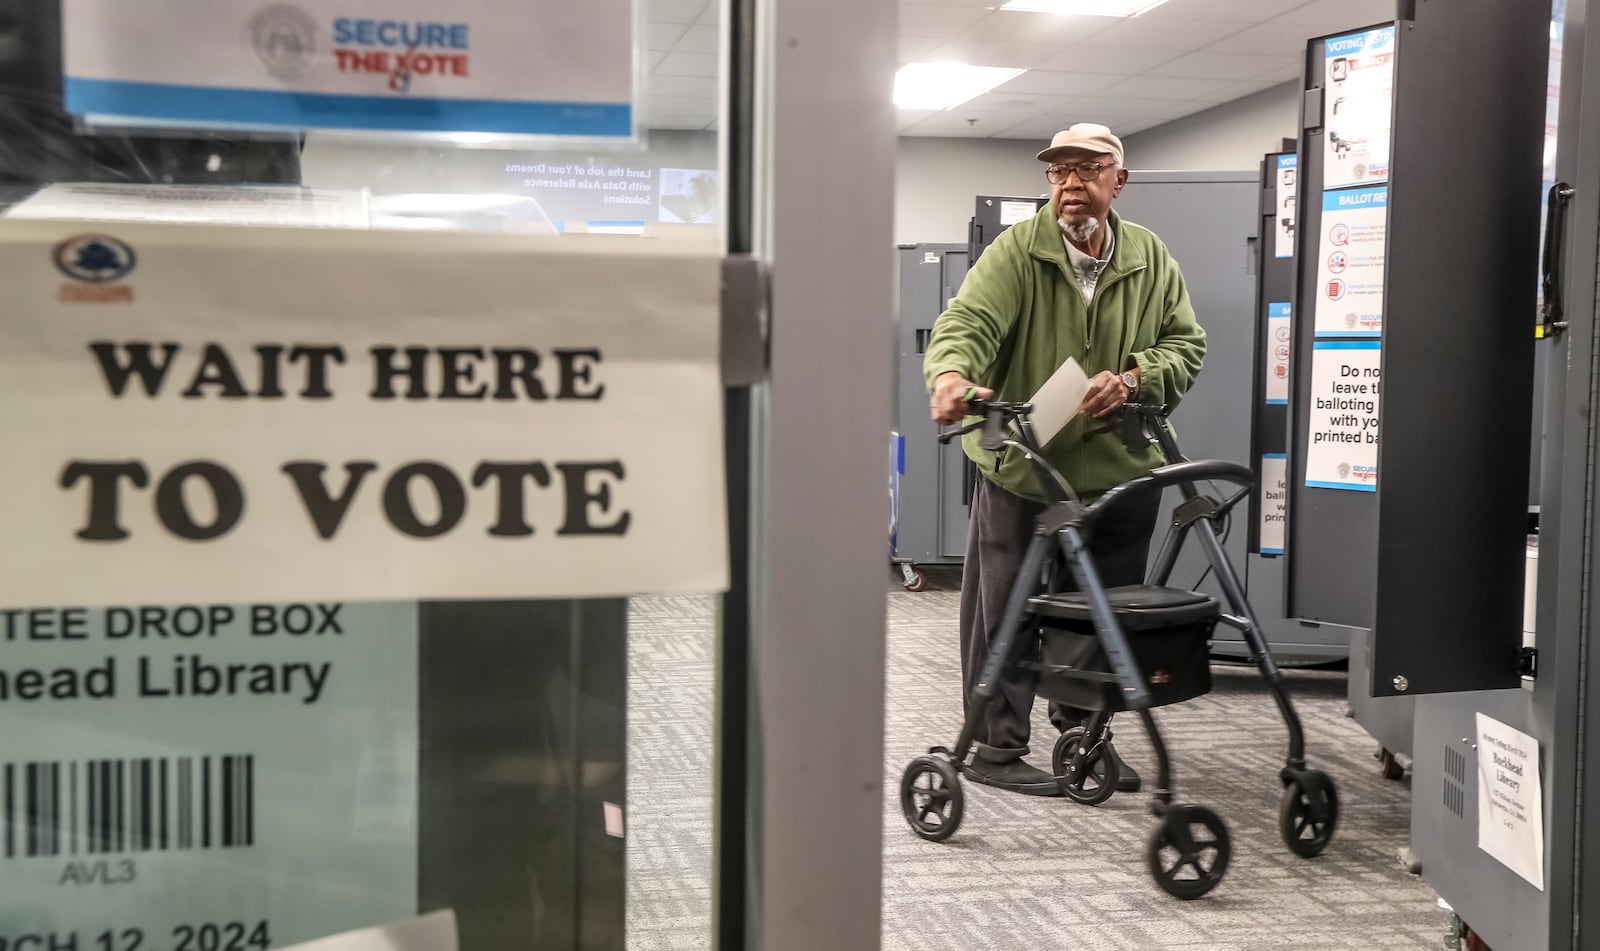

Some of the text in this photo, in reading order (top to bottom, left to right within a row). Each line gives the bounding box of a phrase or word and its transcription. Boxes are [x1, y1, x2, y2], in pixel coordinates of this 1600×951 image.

[333, 17, 469, 48] SECURE
[1327, 37, 1366, 52] VOTING
[333, 50, 387, 73] THE
[1338, 193, 1373, 206] BALLOT
[87, 340, 604, 401] WAIT HERE
[1341, 365, 1359, 377] Do
[1332, 381, 1367, 393] leave
[1316, 397, 1374, 413] balloting
[1330, 414, 1358, 427] with
[1314, 430, 1361, 443] printed
[59, 460, 630, 542] TO VOTE
[106, 606, 234, 638] DROP
[251, 604, 342, 636] BOX
[139, 655, 330, 704] Library
[58, 860, 136, 885] AVL3
[173, 920, 271, 951] 2024
